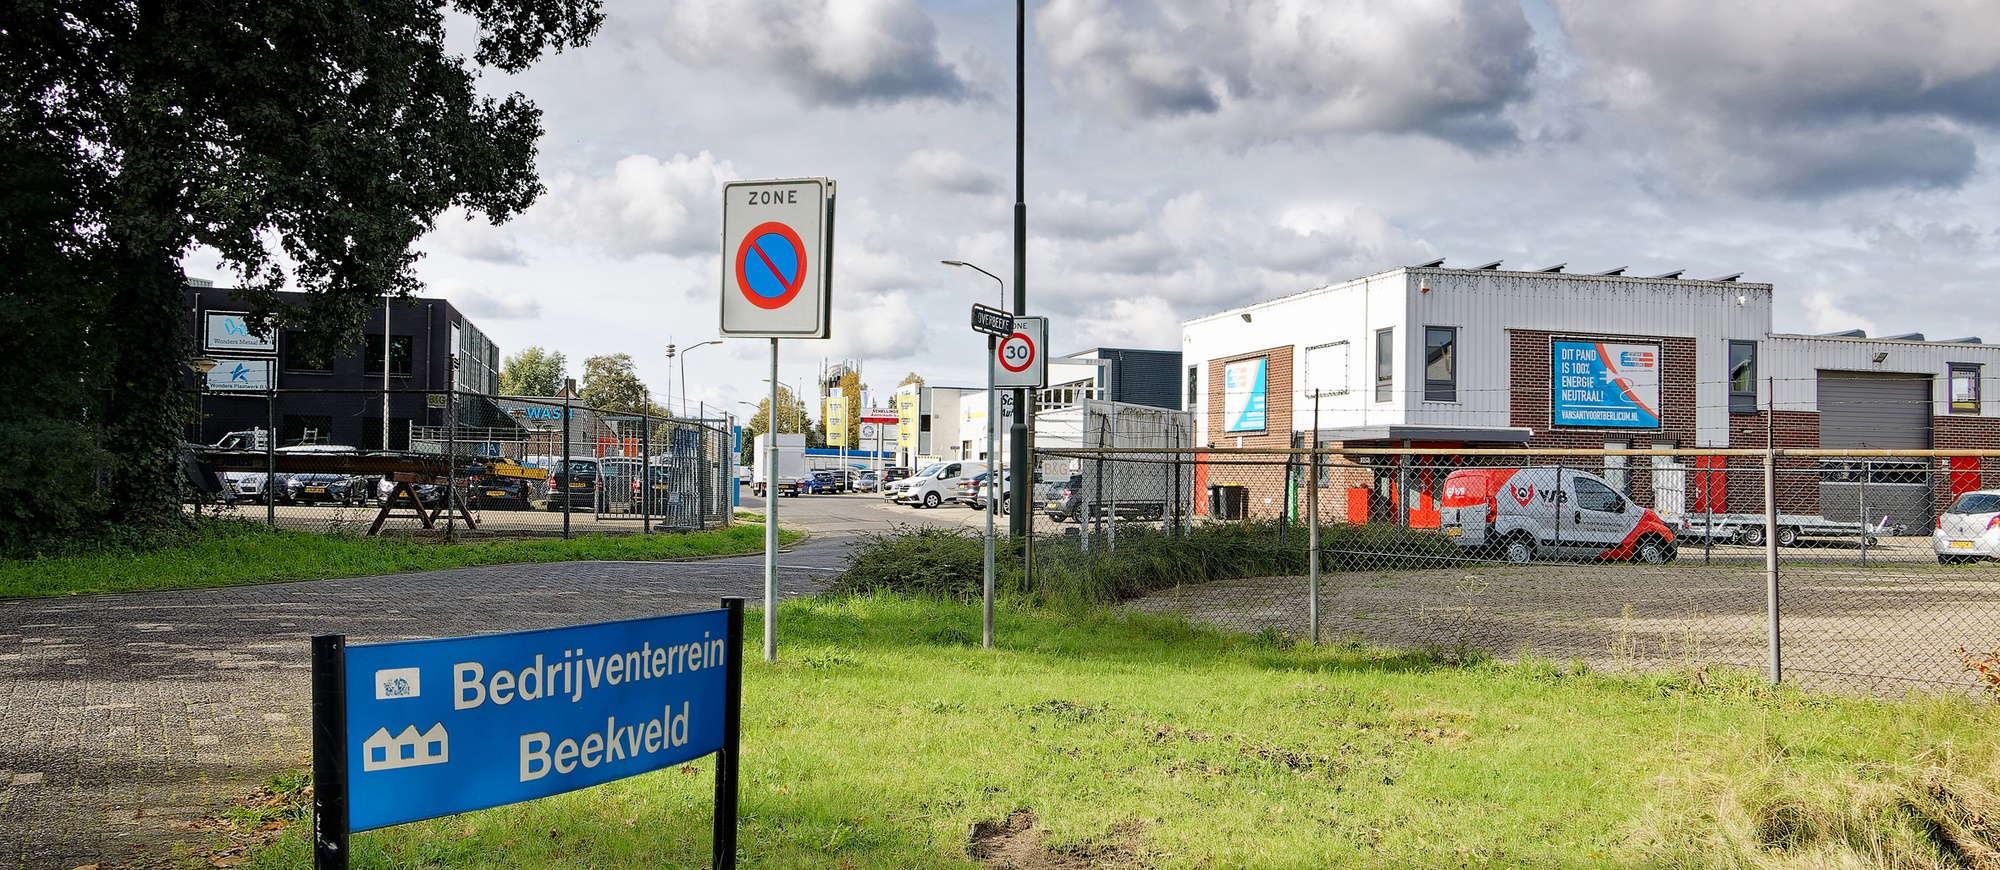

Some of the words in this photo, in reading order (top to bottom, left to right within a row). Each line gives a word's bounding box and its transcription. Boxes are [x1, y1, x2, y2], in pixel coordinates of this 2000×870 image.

[748, 190, 797, 205] ZONE
[978, 312, 1010, 331] OVERBEEKE
[1013, 322, 1028, 330] ONE
[1005, 345, 1028, 360] 30
[1561, 348, 1575, 360] DIT
[1576, 349, 1596, 361] PAND
[1561, 362, 1570, 374] IS
[1572, 362, 1590, 375] 100%
[1561, 376, 1595, 388] ENERGIE
[1561, 389, 1604, 402] NEUTRAAL!
[1561, 410, 1639, 421] VANSANTVOORTBERLICUM.NL
[1045, 461, 1068, 475] B&G
[454, 631, 724, 711] Bedrijventerrein
[519, 701, 689, 782] Beekveld
